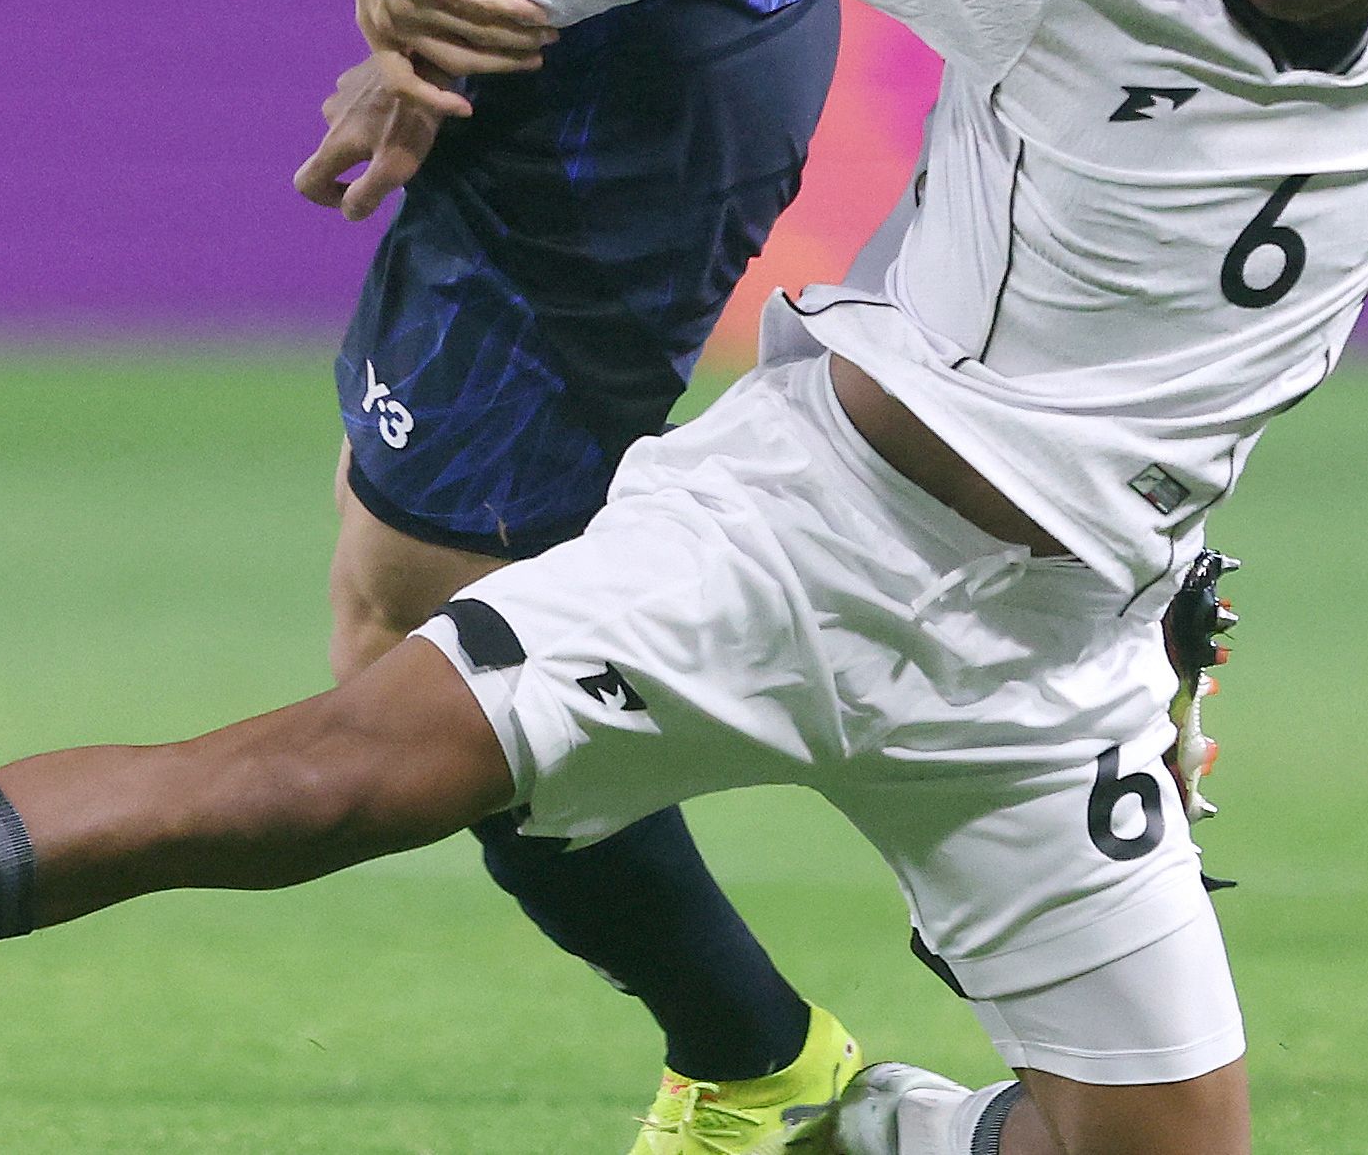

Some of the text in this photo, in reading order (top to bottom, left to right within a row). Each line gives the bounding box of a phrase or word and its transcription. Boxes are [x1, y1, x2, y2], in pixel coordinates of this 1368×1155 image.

[1220, 172, 1308, 310] 6
[361, 358, 415, 449] Y-3
[1087, 744, 1166, 861] 6
